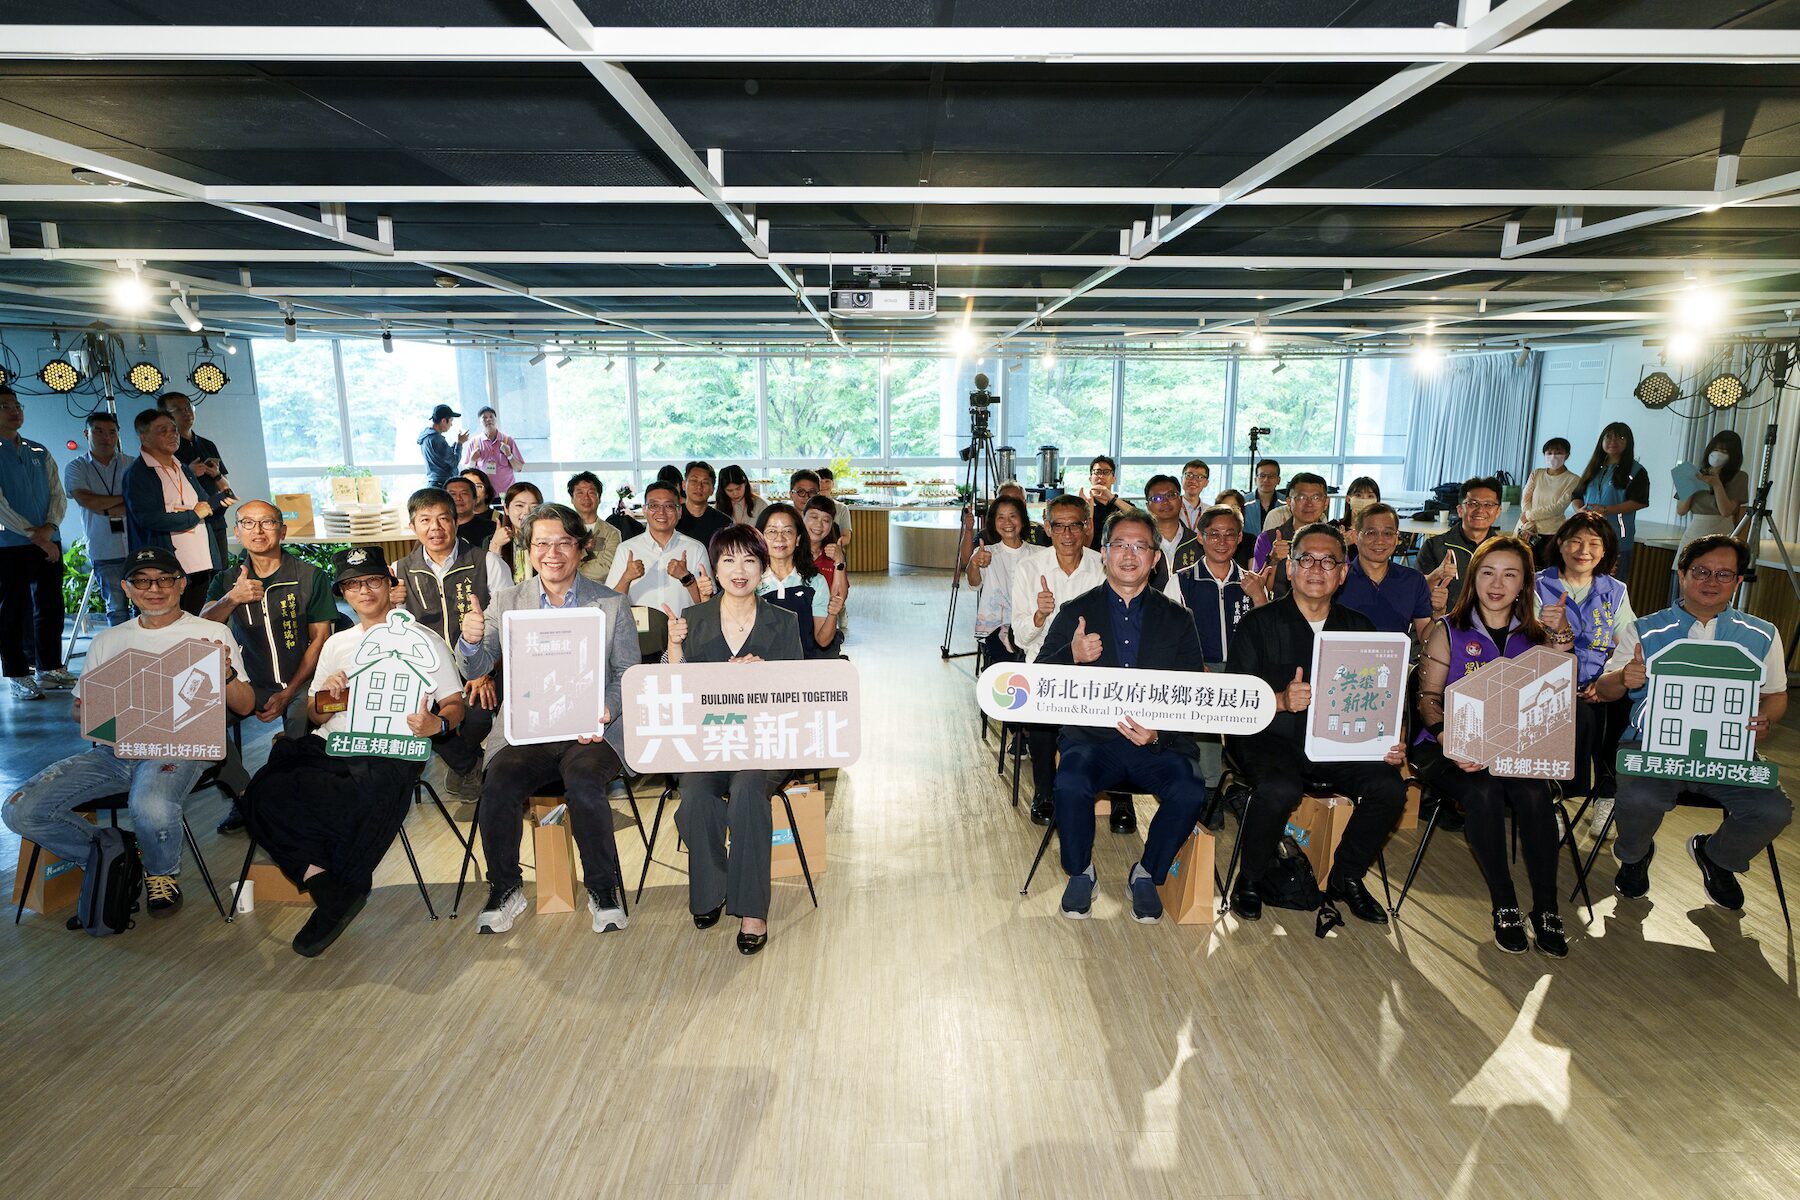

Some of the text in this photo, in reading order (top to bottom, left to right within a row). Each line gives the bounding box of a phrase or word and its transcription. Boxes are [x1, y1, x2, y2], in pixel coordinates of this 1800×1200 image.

[701, 690, 848, 705] BUILDING NEW TAIPEI TOGETHER
[1037, 677, 1260, 710] 新北市政府城鄉發展局
[1342, 691, 1379, 713] 新北
[636, 674, 850, 764] 共築新北
[1036, 702, 1258, 724] Urban&Rural Development Department
[118, 743, 221, 758] 共築新北好所在
[331, 735, 427, 757] 社區規劃師
[1494, 756, 1571, 778] 城鄉共好
[1624, 753, 1771, 785] 看見新北的改變
